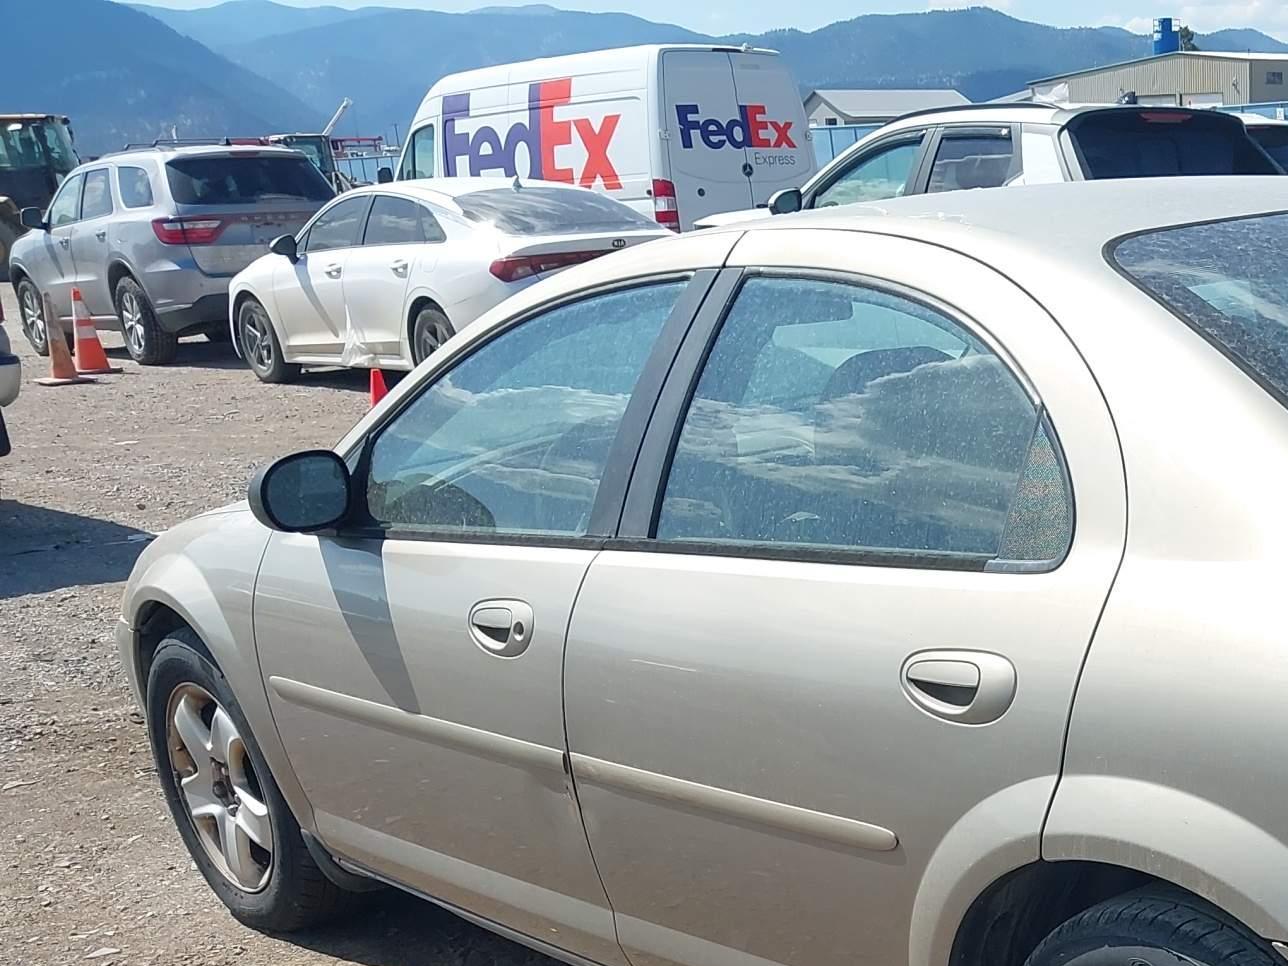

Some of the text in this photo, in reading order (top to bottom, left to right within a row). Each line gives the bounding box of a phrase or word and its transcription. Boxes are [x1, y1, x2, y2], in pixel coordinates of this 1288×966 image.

[442, 78, 624, 190] FedEx
[675, 104, 797, 149] FedEx
[754, 152, 796, 167] Express
